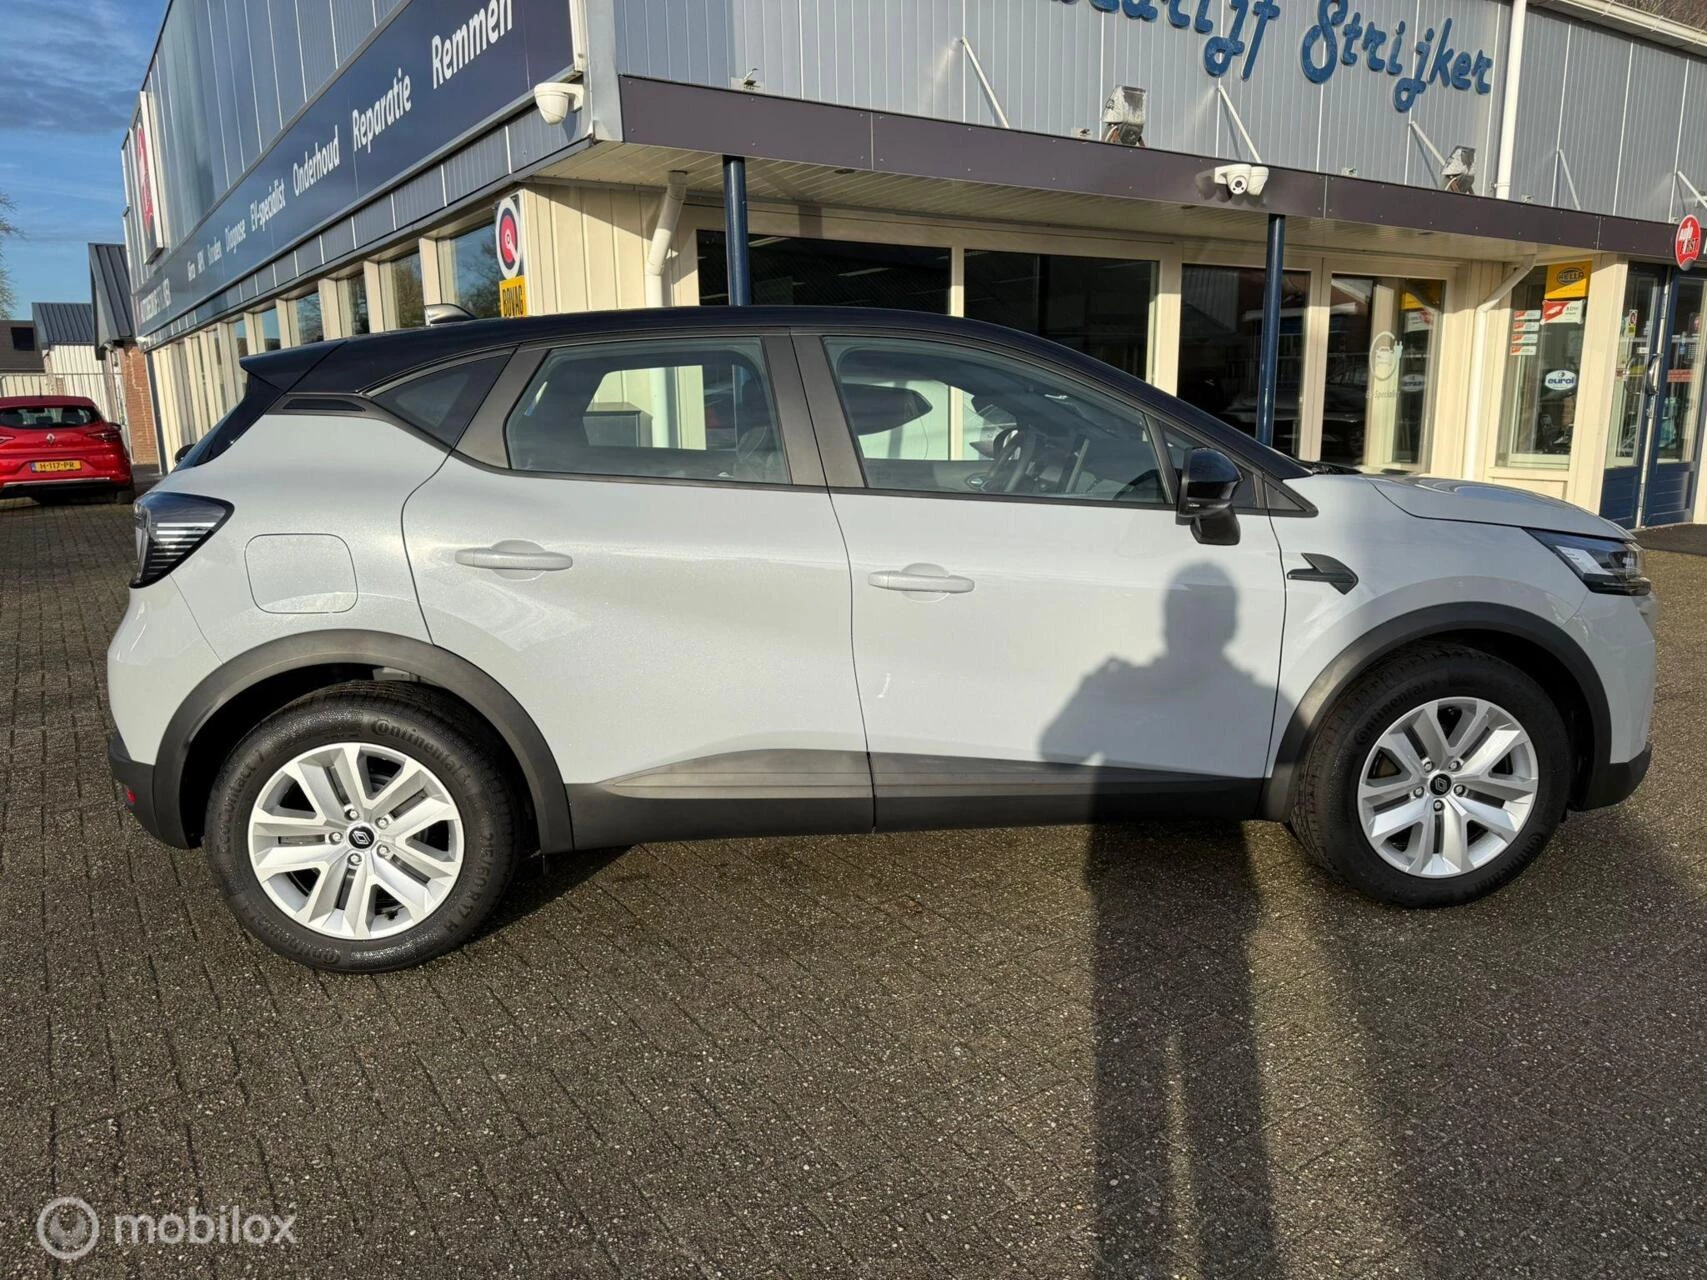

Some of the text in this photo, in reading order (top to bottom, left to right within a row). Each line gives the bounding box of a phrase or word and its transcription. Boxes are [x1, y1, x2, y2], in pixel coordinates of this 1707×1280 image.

[1300, 0, 1494, 113] Strijker
[250, 177, 286, 232] EV-specialist
[292, 124, 341, 197] Onderhoud
[352, 67, 412, 153] Reparatie
[431, 0, 513, 90] Remmen
[502, 284, 524, 317] BOVAG
[1547, 376, 1574, 385] eurol
[371, 719, 462, 776] Continental
